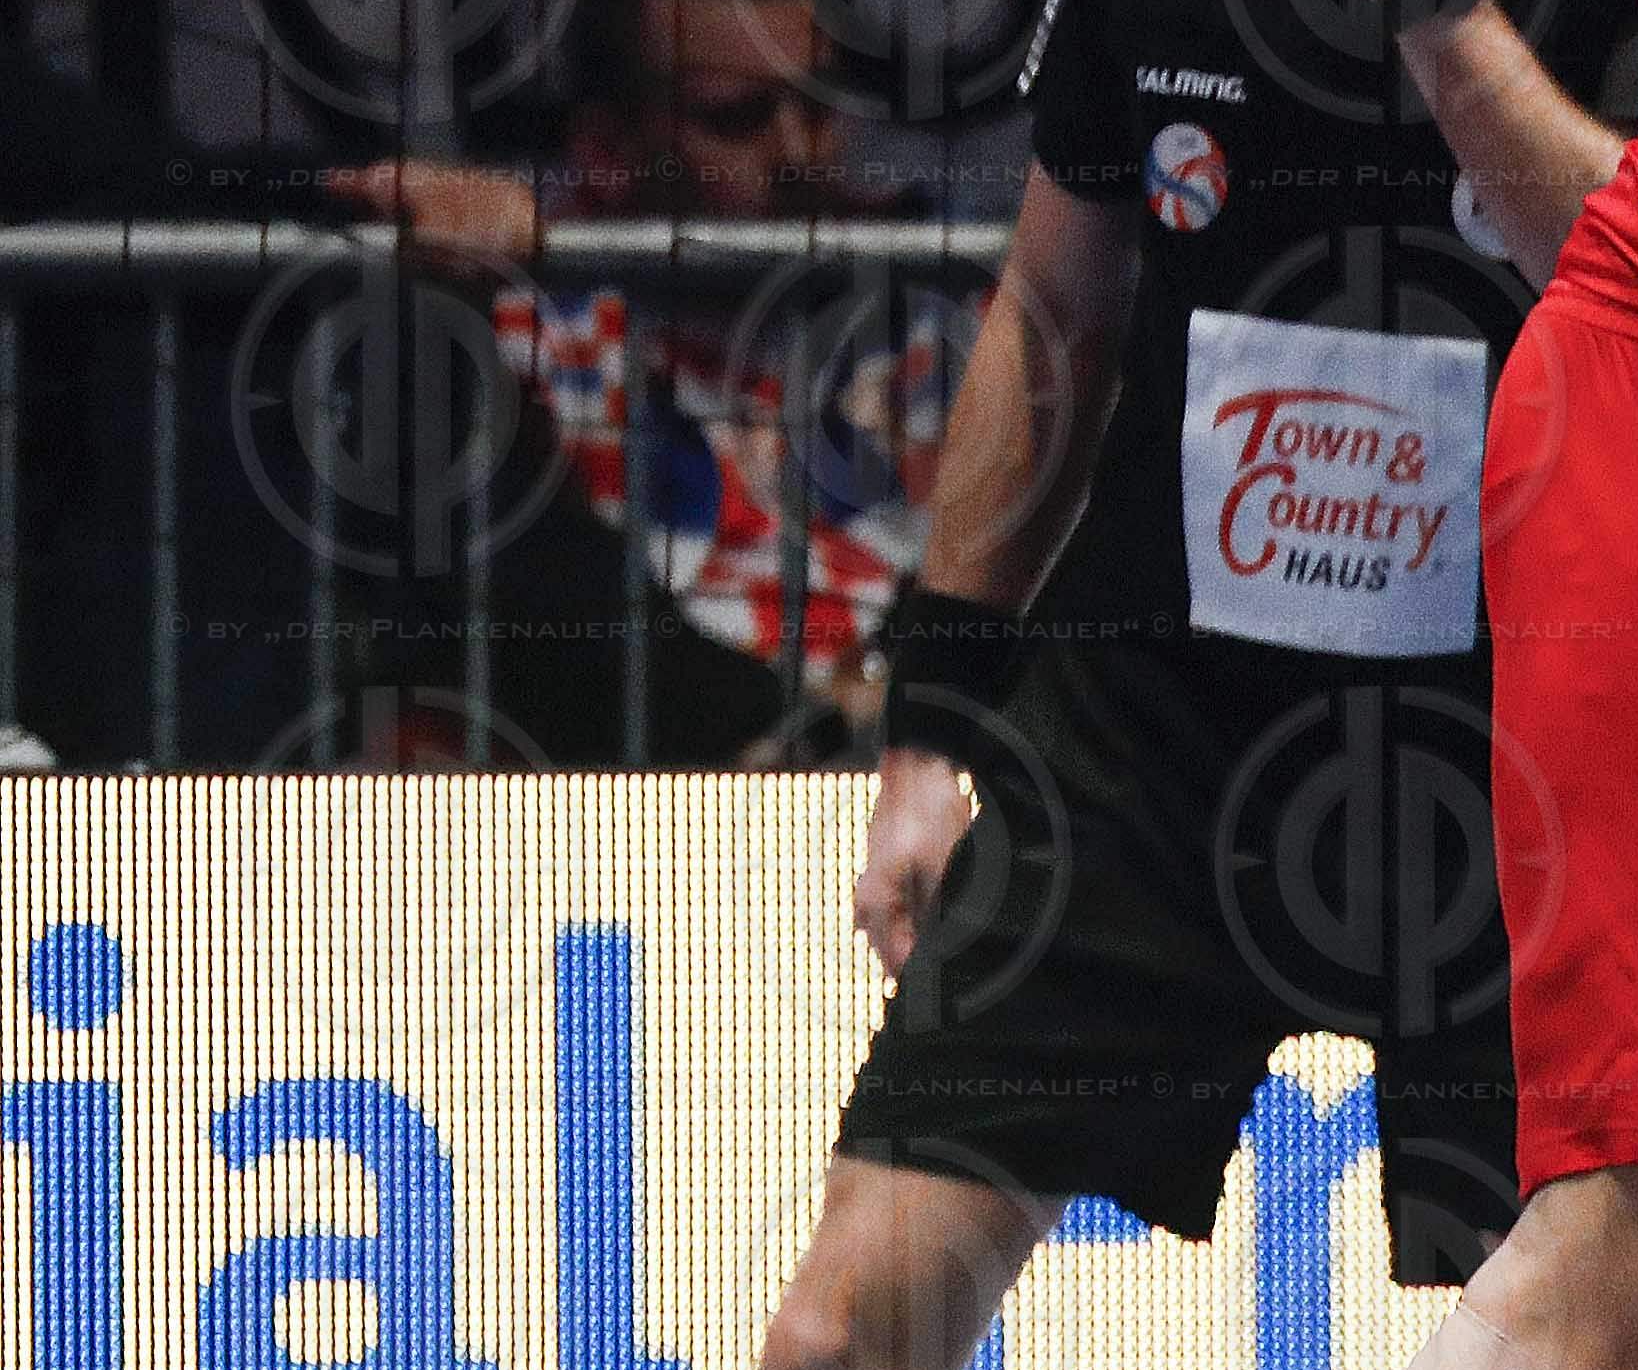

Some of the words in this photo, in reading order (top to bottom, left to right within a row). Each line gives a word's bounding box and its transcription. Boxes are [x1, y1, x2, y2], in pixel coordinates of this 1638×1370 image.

[1213, 387, 1410, 473] Town
[1385, 432, 1427, 485] &
[1219, 461, 1449, 577] Country
[1283, 545, 1393, 592] HAUS
